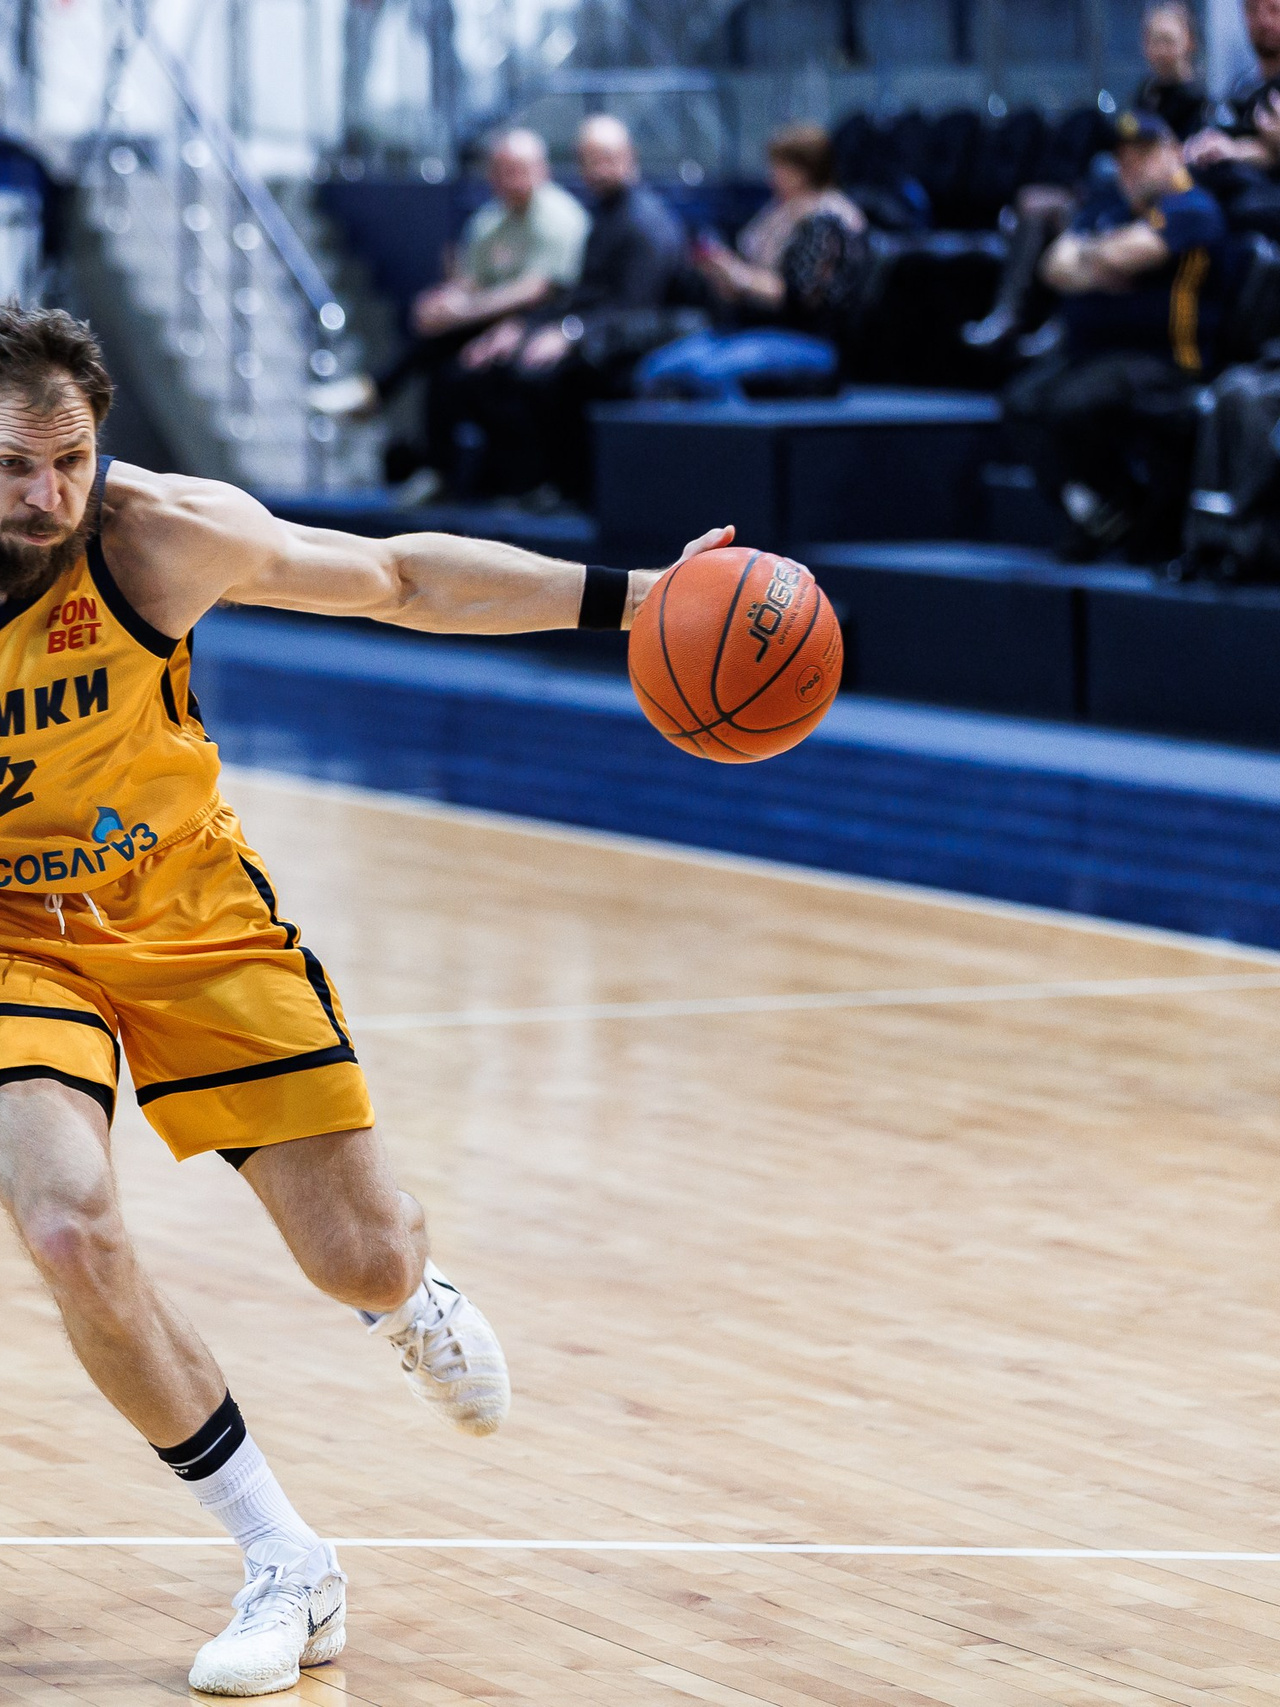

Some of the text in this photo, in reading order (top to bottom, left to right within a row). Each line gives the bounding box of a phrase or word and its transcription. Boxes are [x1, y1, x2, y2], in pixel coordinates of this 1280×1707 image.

[46, 597, 98, 629] FON
[747, 560, 801, 663] JÖGE
[46, 622, 102, 655] BET
